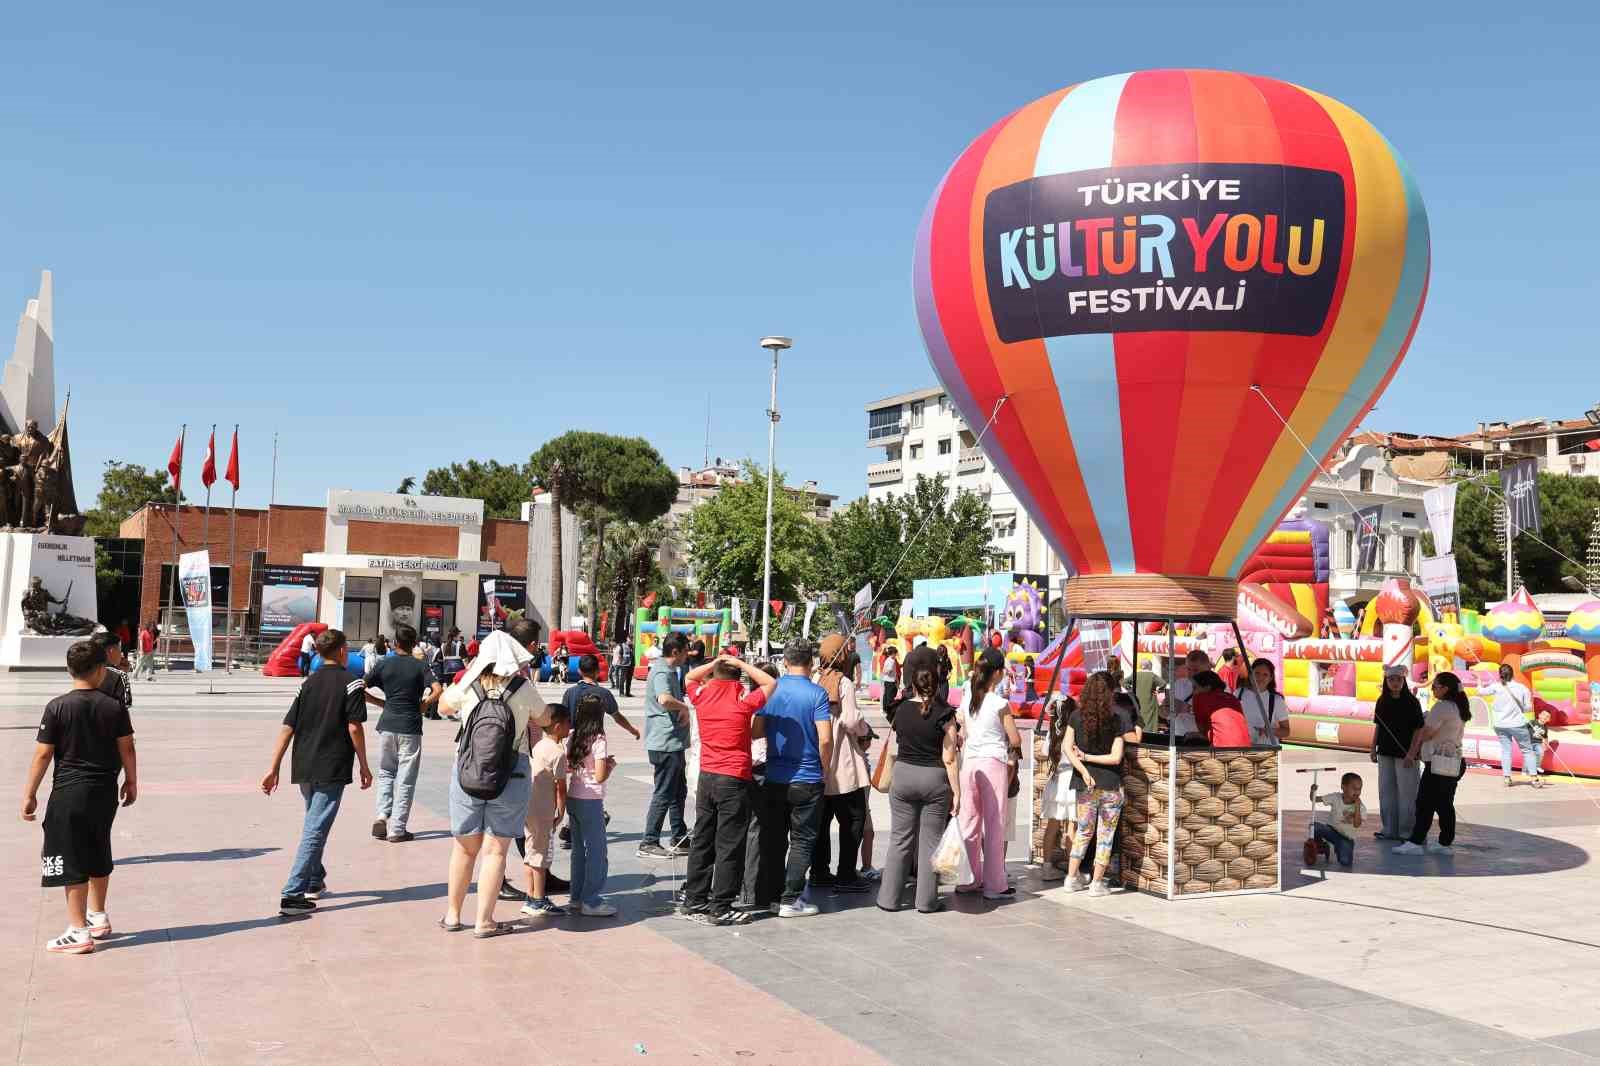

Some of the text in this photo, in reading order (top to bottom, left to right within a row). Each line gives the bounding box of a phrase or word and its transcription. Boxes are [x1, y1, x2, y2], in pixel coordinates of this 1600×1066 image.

[1077, 174, 1241, 206] TÜRKİYE
[999, 212, 1326, 289] KÜLTÜR YOLU
[1068, 280, 1247, 314] FESTİVALİ
